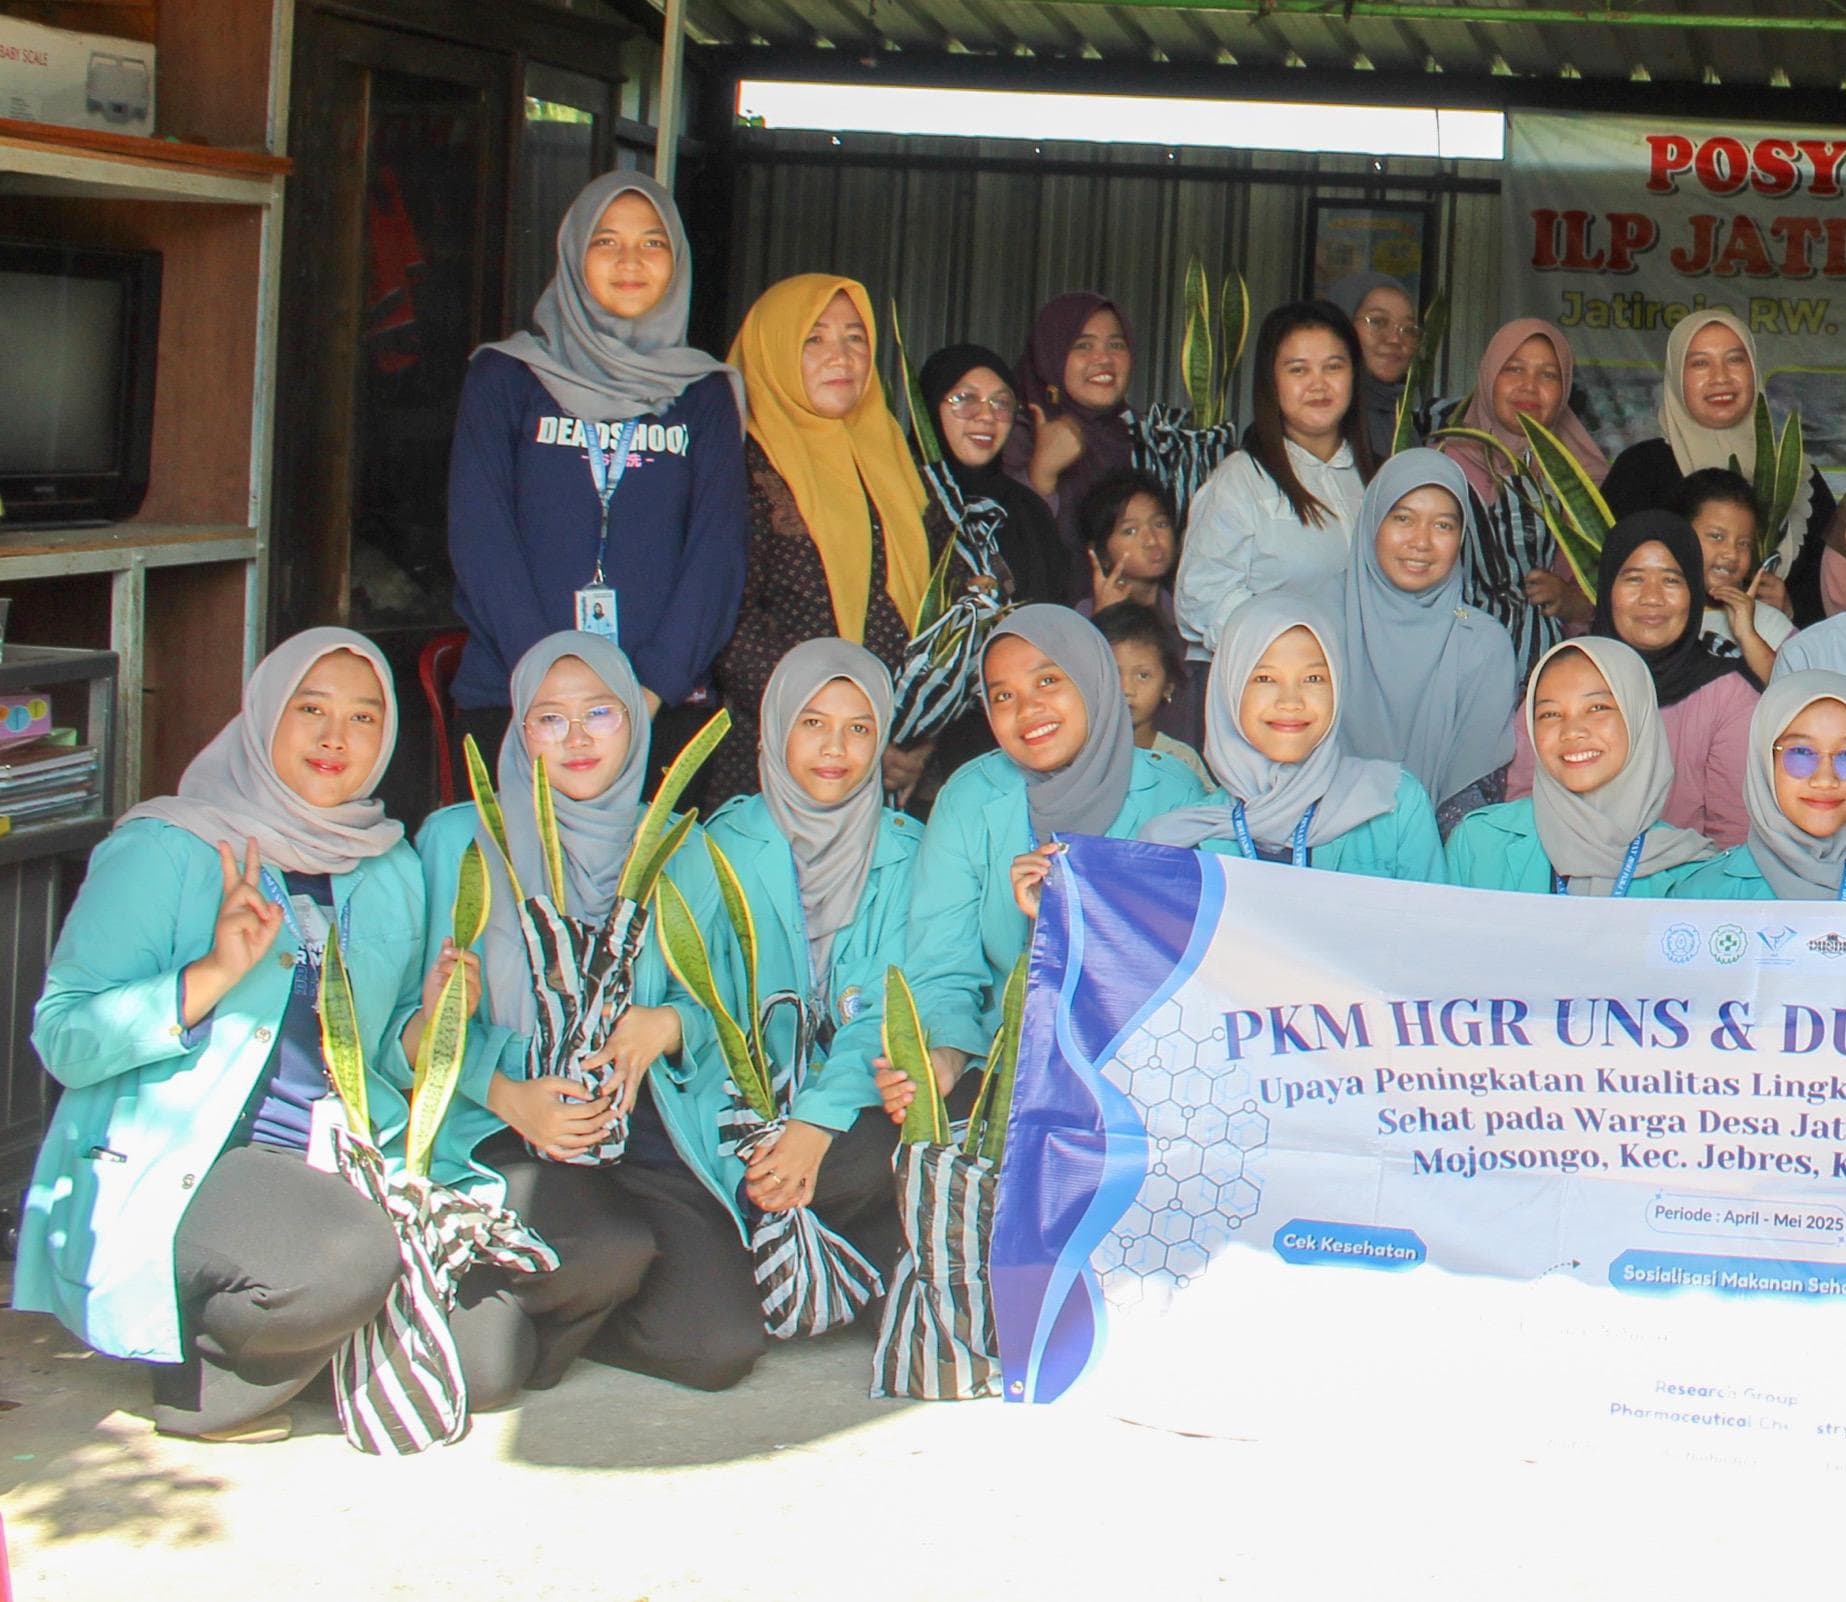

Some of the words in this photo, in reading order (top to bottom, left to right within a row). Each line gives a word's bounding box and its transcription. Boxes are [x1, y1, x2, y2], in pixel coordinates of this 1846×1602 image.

[1531, 209, 1658, 274] ILP
[1558, 291, 1736, 331] Jatire
[1750, 297, 1840, 336] RW.
[1221, 1002, 1374, 1062] PKM
[1388, 998, 1532, 1048] HGR
[1556, 998, 1689, 1049] UNS
[1710, 1000, 1757, 1052] &
[1260, 1072, 1365, 1108] Upaya
[1375, 1066, 1585, 1096] Peningkatan
[1596, 1067, 1740, 1097] Kualitas
[1378, 1107, 1475, 1136] Sehat
[1485, 1107, 1565, 1136] pada
[1571, 1107, 1687, 1139] Warga
[1698, 1109, 1780, 1137] Desa
[1411, 1145, 1610, 1178] Mojosongo,
[1619, 1143, 1687, 1169] Kec.
[1697, 1143, 1820, 1180] Jebres,
[1654, 1205, 1712, 1223] Periode
[1723, 1209, 1759, 1227] April
[1774, 1213, 1802, 1229] Mei
[1806, 1215, 1844, 1231] 2025
[1283, 1233, 1317, 1250] Cek
[1321, 1236, 1418, 1260] Kesehatan
[1624, 1265, 1717, 1288] Sosialisasi
[1720, 1271, 1804, 1292] Makanan
